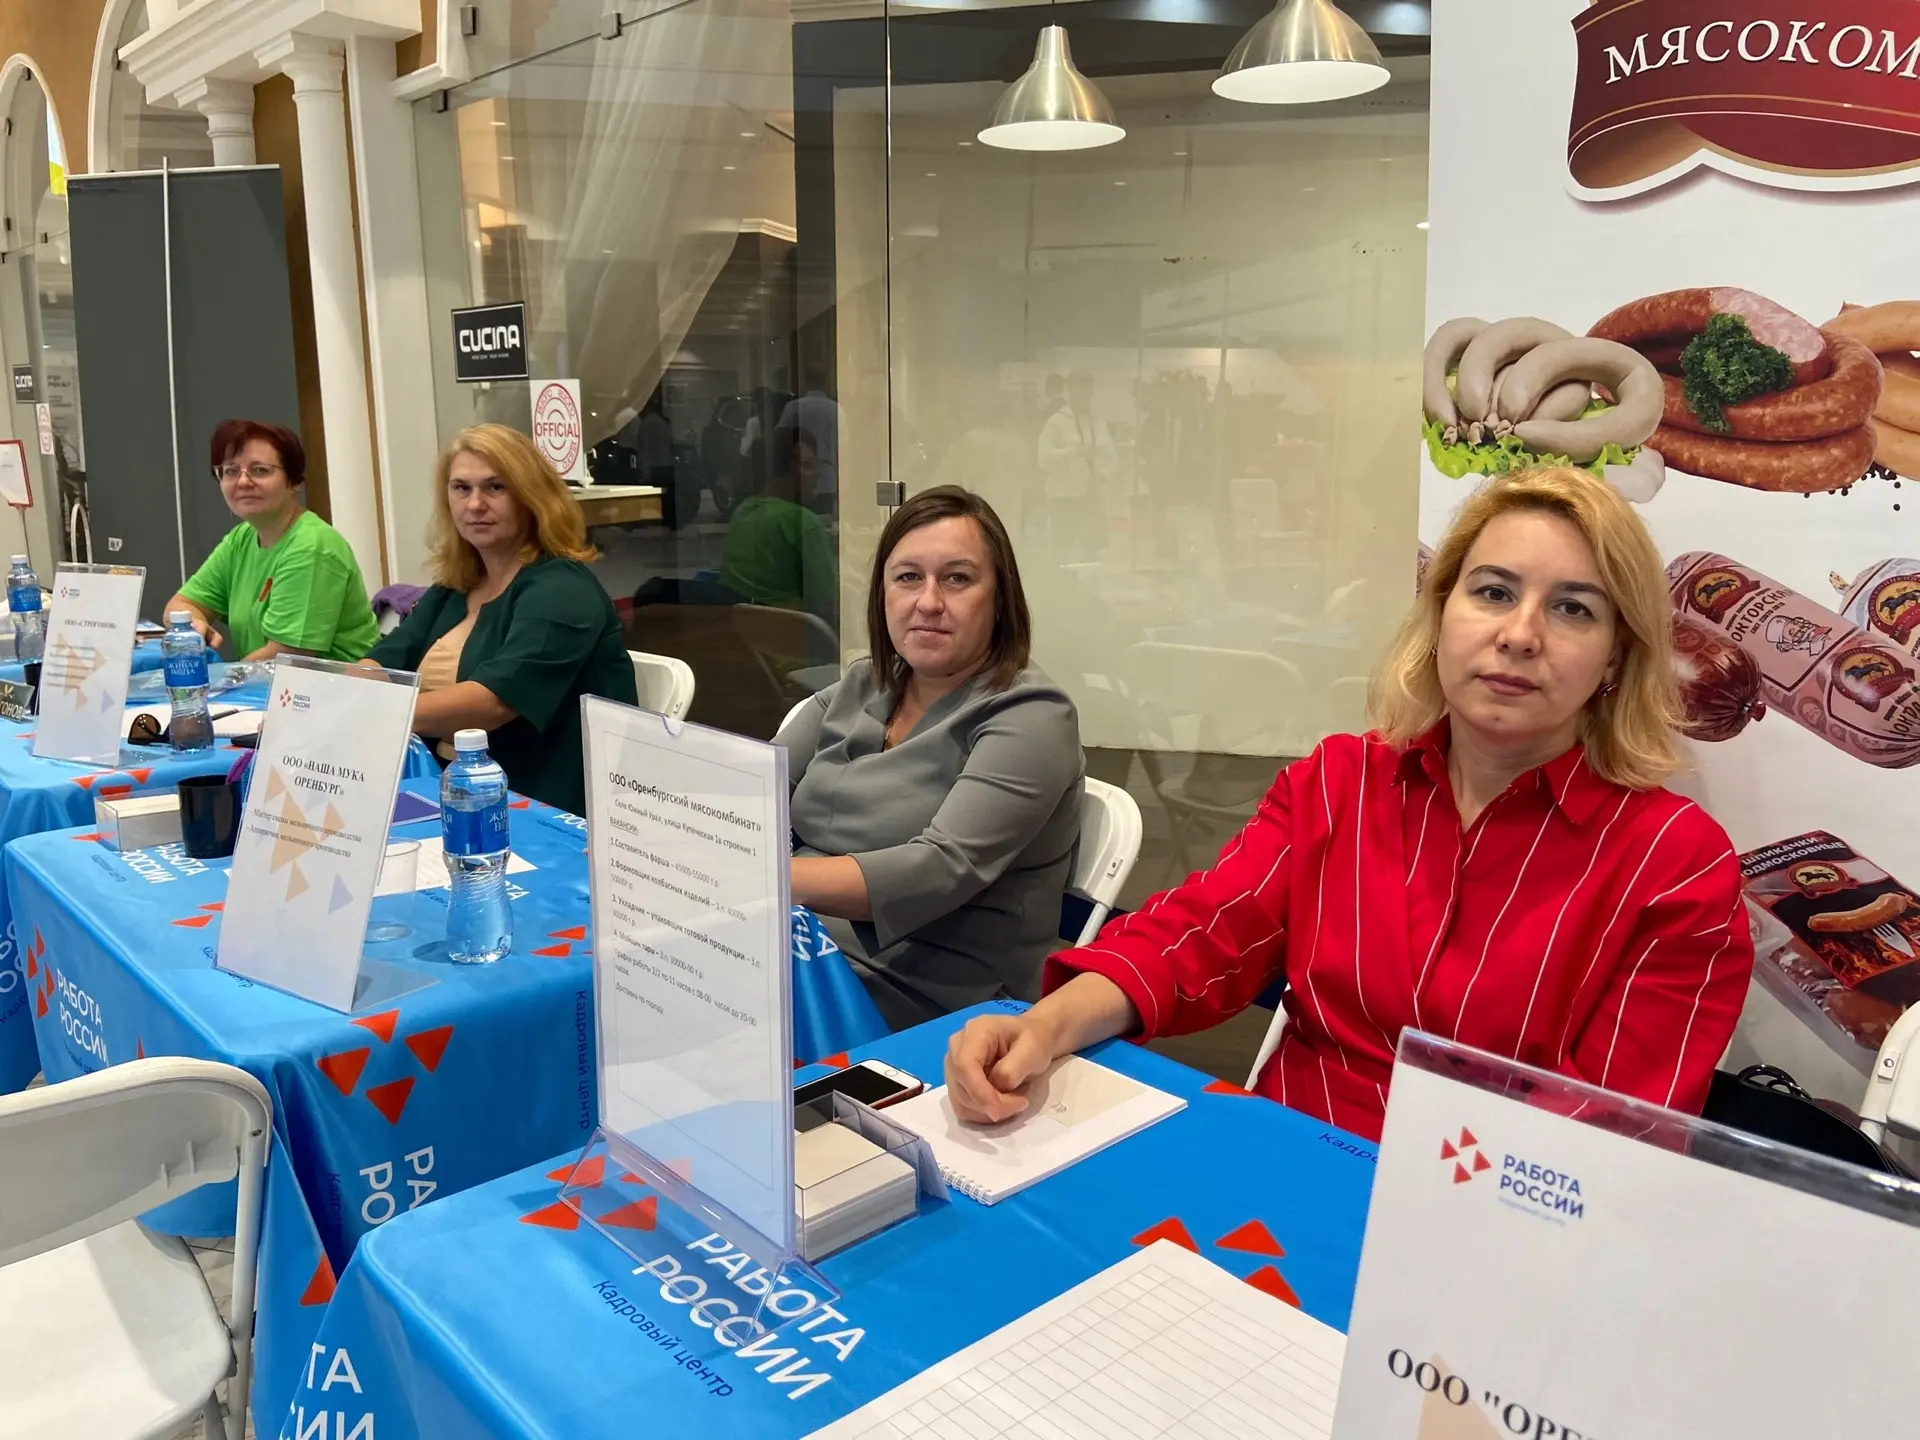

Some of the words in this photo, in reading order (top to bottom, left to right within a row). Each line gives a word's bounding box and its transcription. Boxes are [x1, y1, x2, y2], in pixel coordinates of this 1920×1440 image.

[1603, 20, 1920, 85] МЯСОКОМ
[459, 325, 520, 353] CUCINA
[535, 423, 580, 438] OFFICIAL
[1731, 588, 1793, 642] ОКТОРСКА
[282, 755, 303, 768] ООО
[304, 760, 335, 777] «НАША
[337, 766, 365, 782] МУКА
[294, 775, 345, 796] ОРЕНБУРГ»
[609, 771, 626, 787] ООО
[627, 779, 689, 808] «Оренбургский
[690, 801, 761, 832] мясокомбинат»
[650, 852, 670, 868] фарша
[1741, 837, 1819, 865] ШПИКАЧКИ
[1742, 841, 1847, 876] ОДМОСКОВНЫЕ
[651, 876, 683, 895] колбасных
[684, 889, 710, 908] изделий
[684, 927, 708, 944] готовой
[709, 938, 745, 961] продукции
[57, 968, 103, 1032] РАБОТА
[60, 1001, 110, 1068] РОССИИ
[575, 989, 590, 1076] Кадровый
[577, 1079, 591, 1130] центр
[359, 1161, 396, 1225] РО
[405, 1145, 437, 1210] РА
[1499, 1173, 1585, 1219] РОССИИ
[1503, 1153, 1582, 1197] РАБОТА
[686, 1232, 867, 1362] РАБОТА
[592, 1280, 681, 1351] Кадровый
[673, 1343, 734, 1398] центр
[631, 1254, 833, 1400] РОССИИ
[306, 1341, 364, 1394] ТА
[1387, 1348, 1470, 1407] ООО
[1484, 1390, 1598, 1440] "ОРЕ
